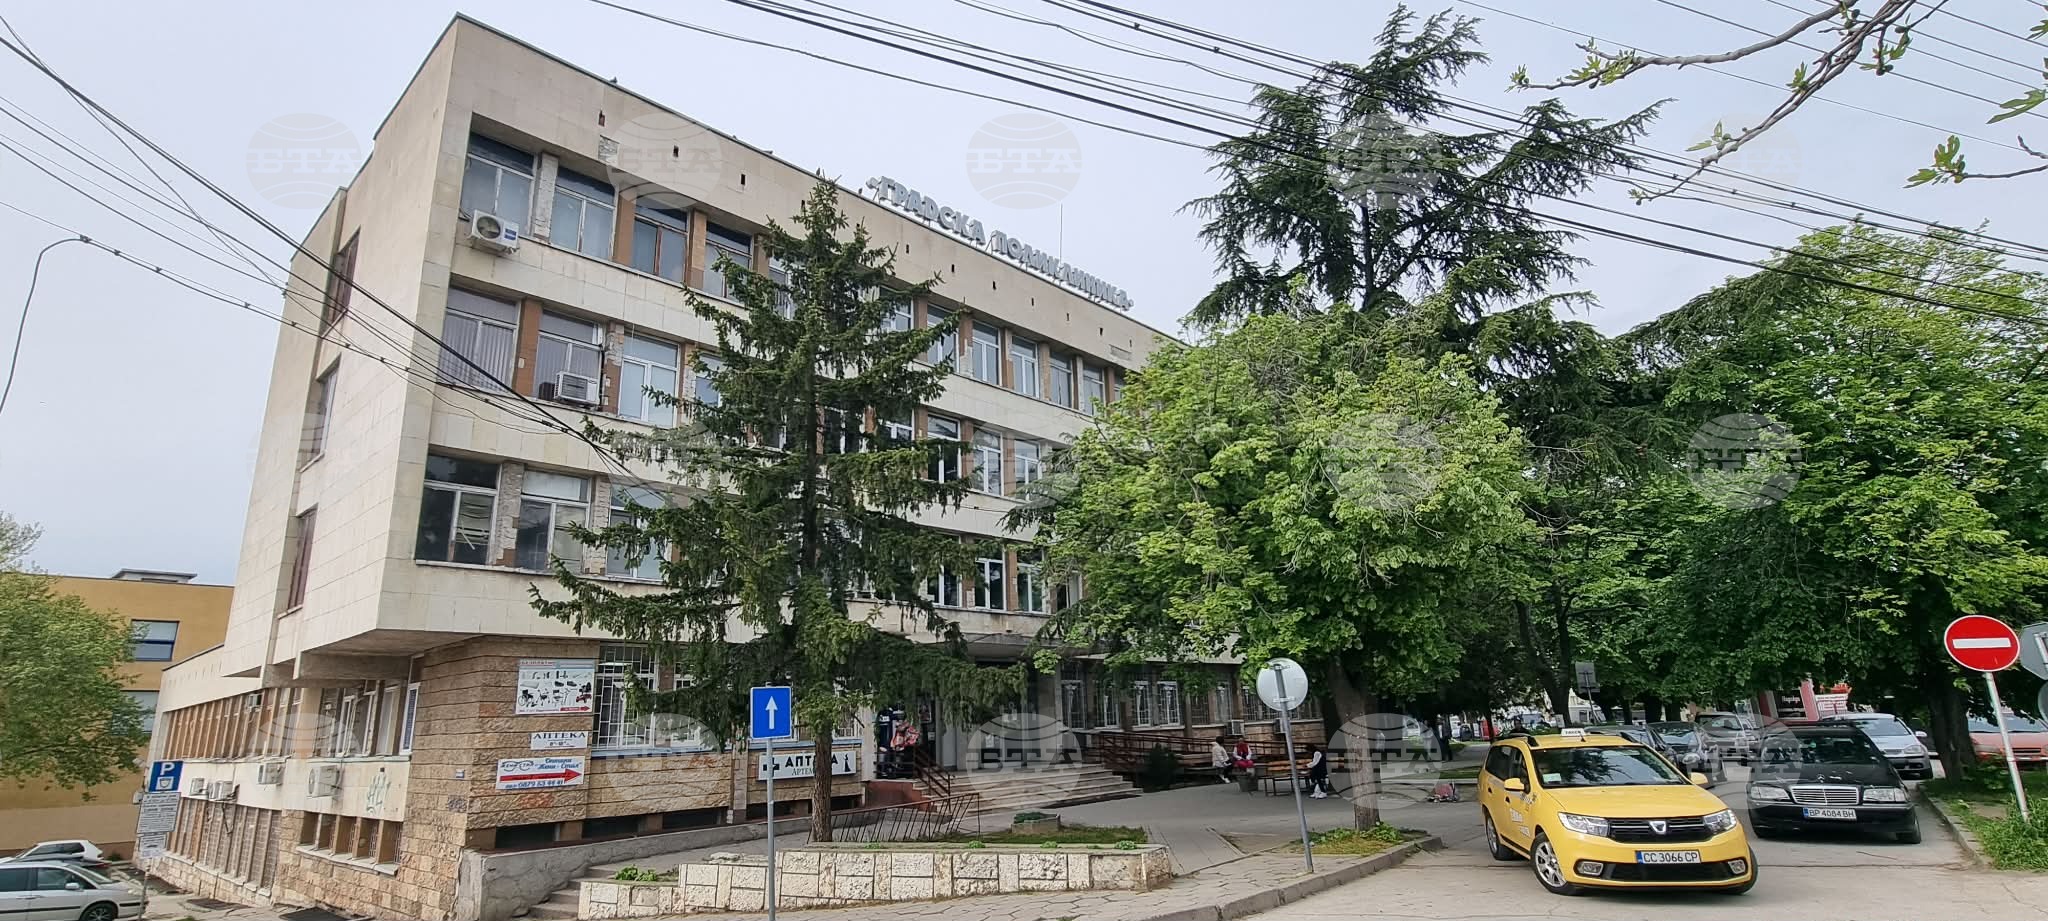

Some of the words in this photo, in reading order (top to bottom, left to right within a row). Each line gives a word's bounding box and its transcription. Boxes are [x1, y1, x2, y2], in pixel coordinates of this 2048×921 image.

[785, 754, 838, 767] АПТА
[160, 762, 175, 775] P
[1643, 853, 1657, 862] CC
[1659, 853, 1683, 862] 3066
